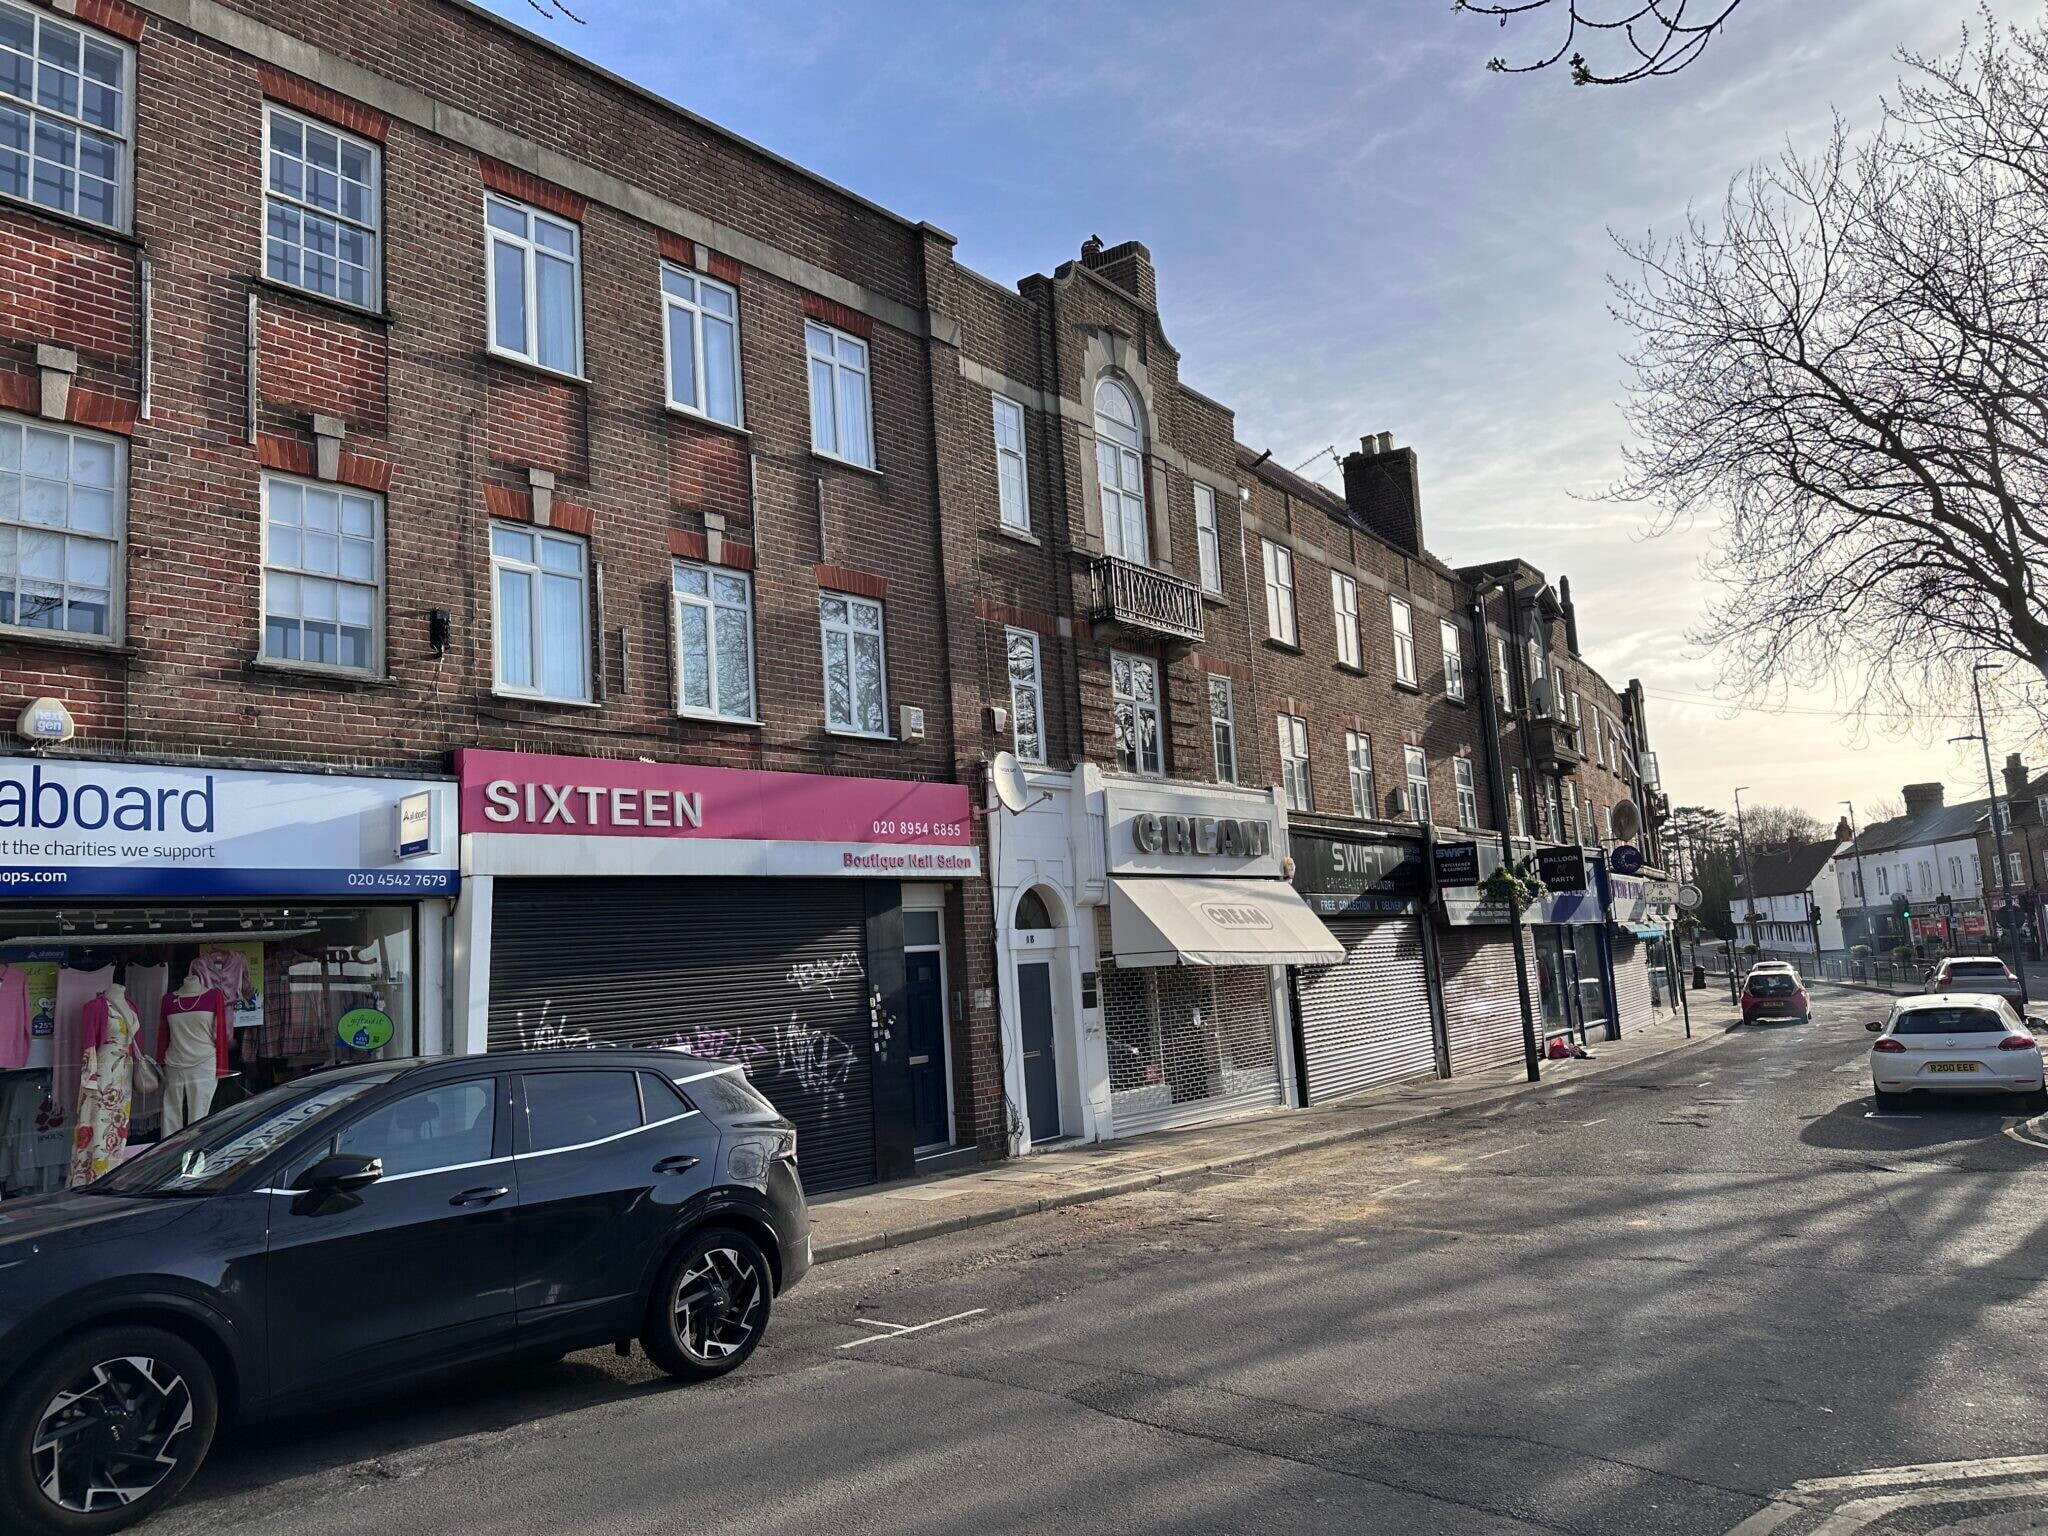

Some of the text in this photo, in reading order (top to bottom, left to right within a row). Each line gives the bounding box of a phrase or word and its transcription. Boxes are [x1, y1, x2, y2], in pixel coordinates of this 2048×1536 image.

[37, 721, 62, 731] gen
[484, 780, 702, 828] SIXTEEN
[873, 821, 961, 836] 020 8954 6855
[1132, 813, 1271, 856] CREAM
[13, 839, 39, 855] the
[44, 840, 116, 857] charities
[121, 846, 149, 857] we
[154, 845, 215, 861] support
[1436, 847, 1474, 858] SWIFT
[843, 852, 971, 870] Boutique Nail Salon
[1331, 842, 1384, 874] SWIFT
[1543, 855, 1578, 863] BALLOON
[0, 871, 67, 885] ops.com
[348, 873, 447, 887] 020 4542 7679
[1326, 877, 1363, 889] DRYCLEANER
[1370, 880, 1395, 891] LAUNDRY
[1320, 900, 1336, 911] FREE
[1339, 900, 1371, 911] COLLECTION
[1207, 908, 1269, 925] CREAM
[1930, 1063, 1975, 1072] R200 EEE
